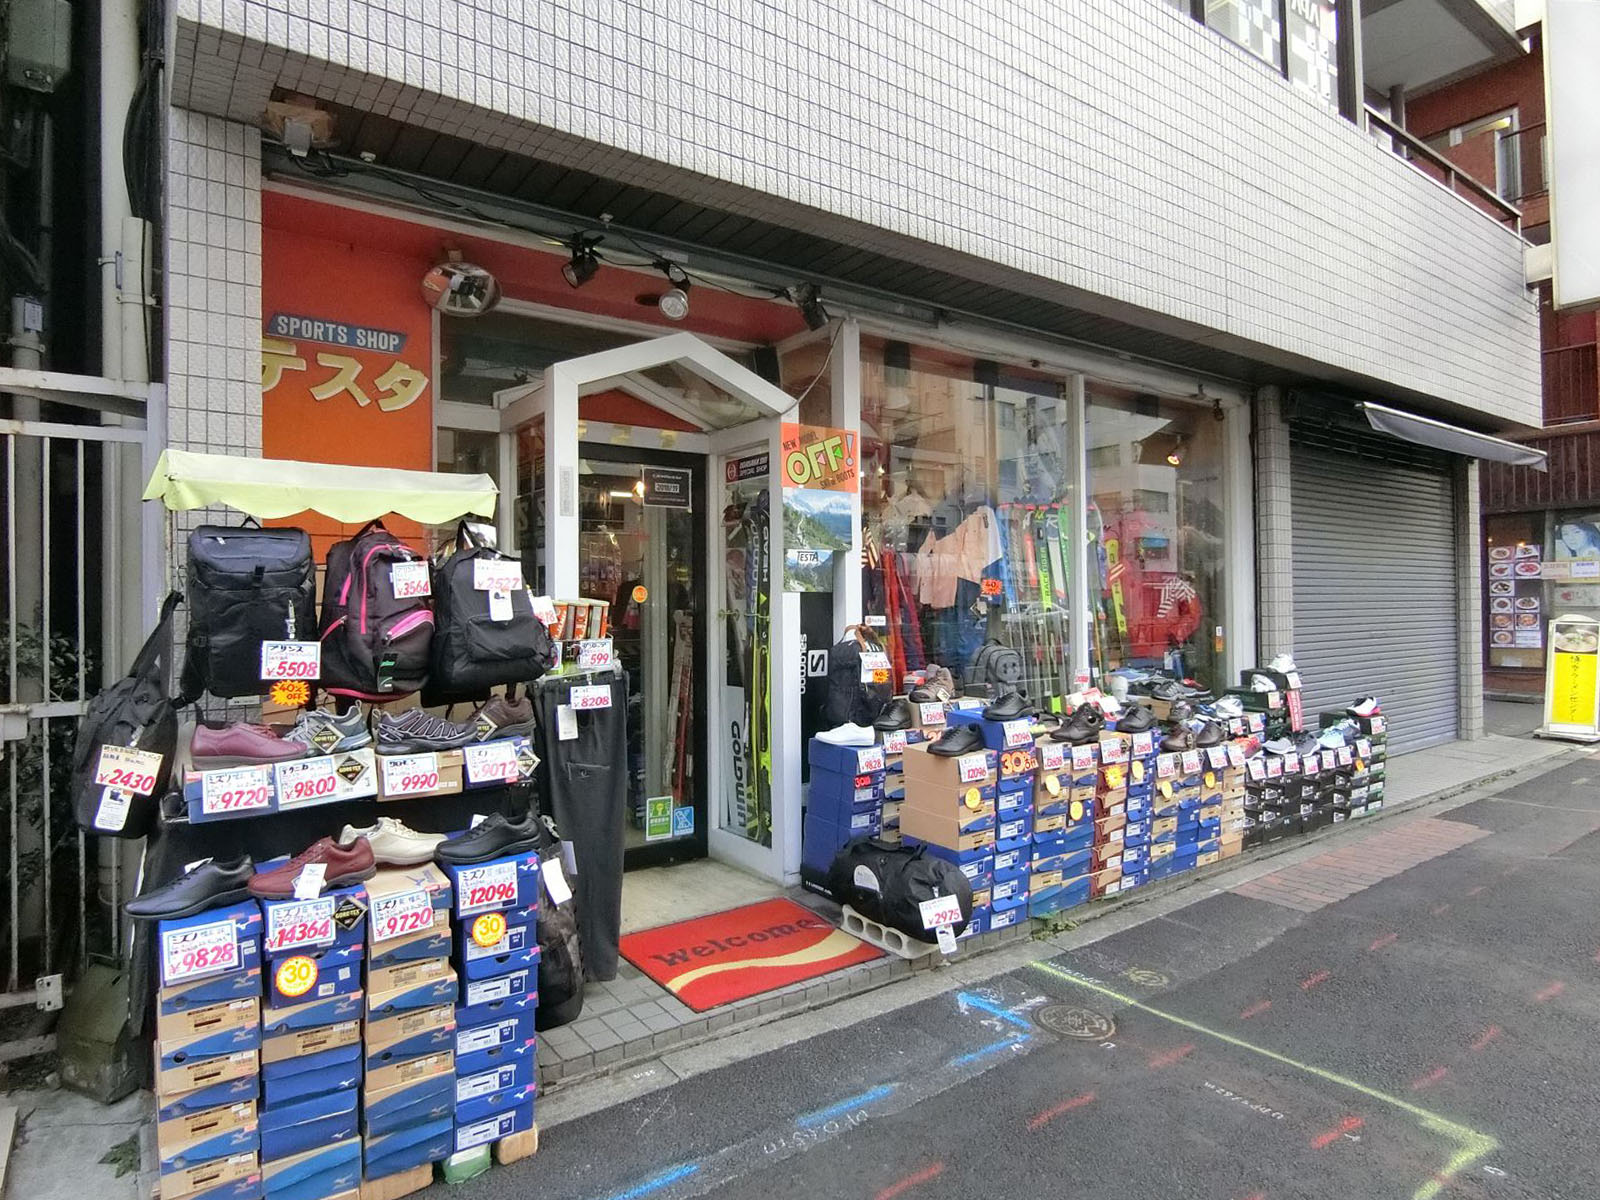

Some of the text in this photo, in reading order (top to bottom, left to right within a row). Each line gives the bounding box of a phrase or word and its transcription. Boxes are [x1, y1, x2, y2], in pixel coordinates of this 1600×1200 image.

[277, 316, 400, 351] SPORTS SHOP
[270, 645, 304, 653] プリンス
[266, 661, 318, 678] ¥5508
[99, 768, 155, 793] ¥2430
[208, 786, 268, 810] ¥9720
[462, 870, 486, 881] ミズノ
[268, 919, 332, 949] ¥14364
[376, 907, 434, 938] ¥9720
[653, 918, 815, 967] Welcome
[168, 942, 236, 976] ¥9828
